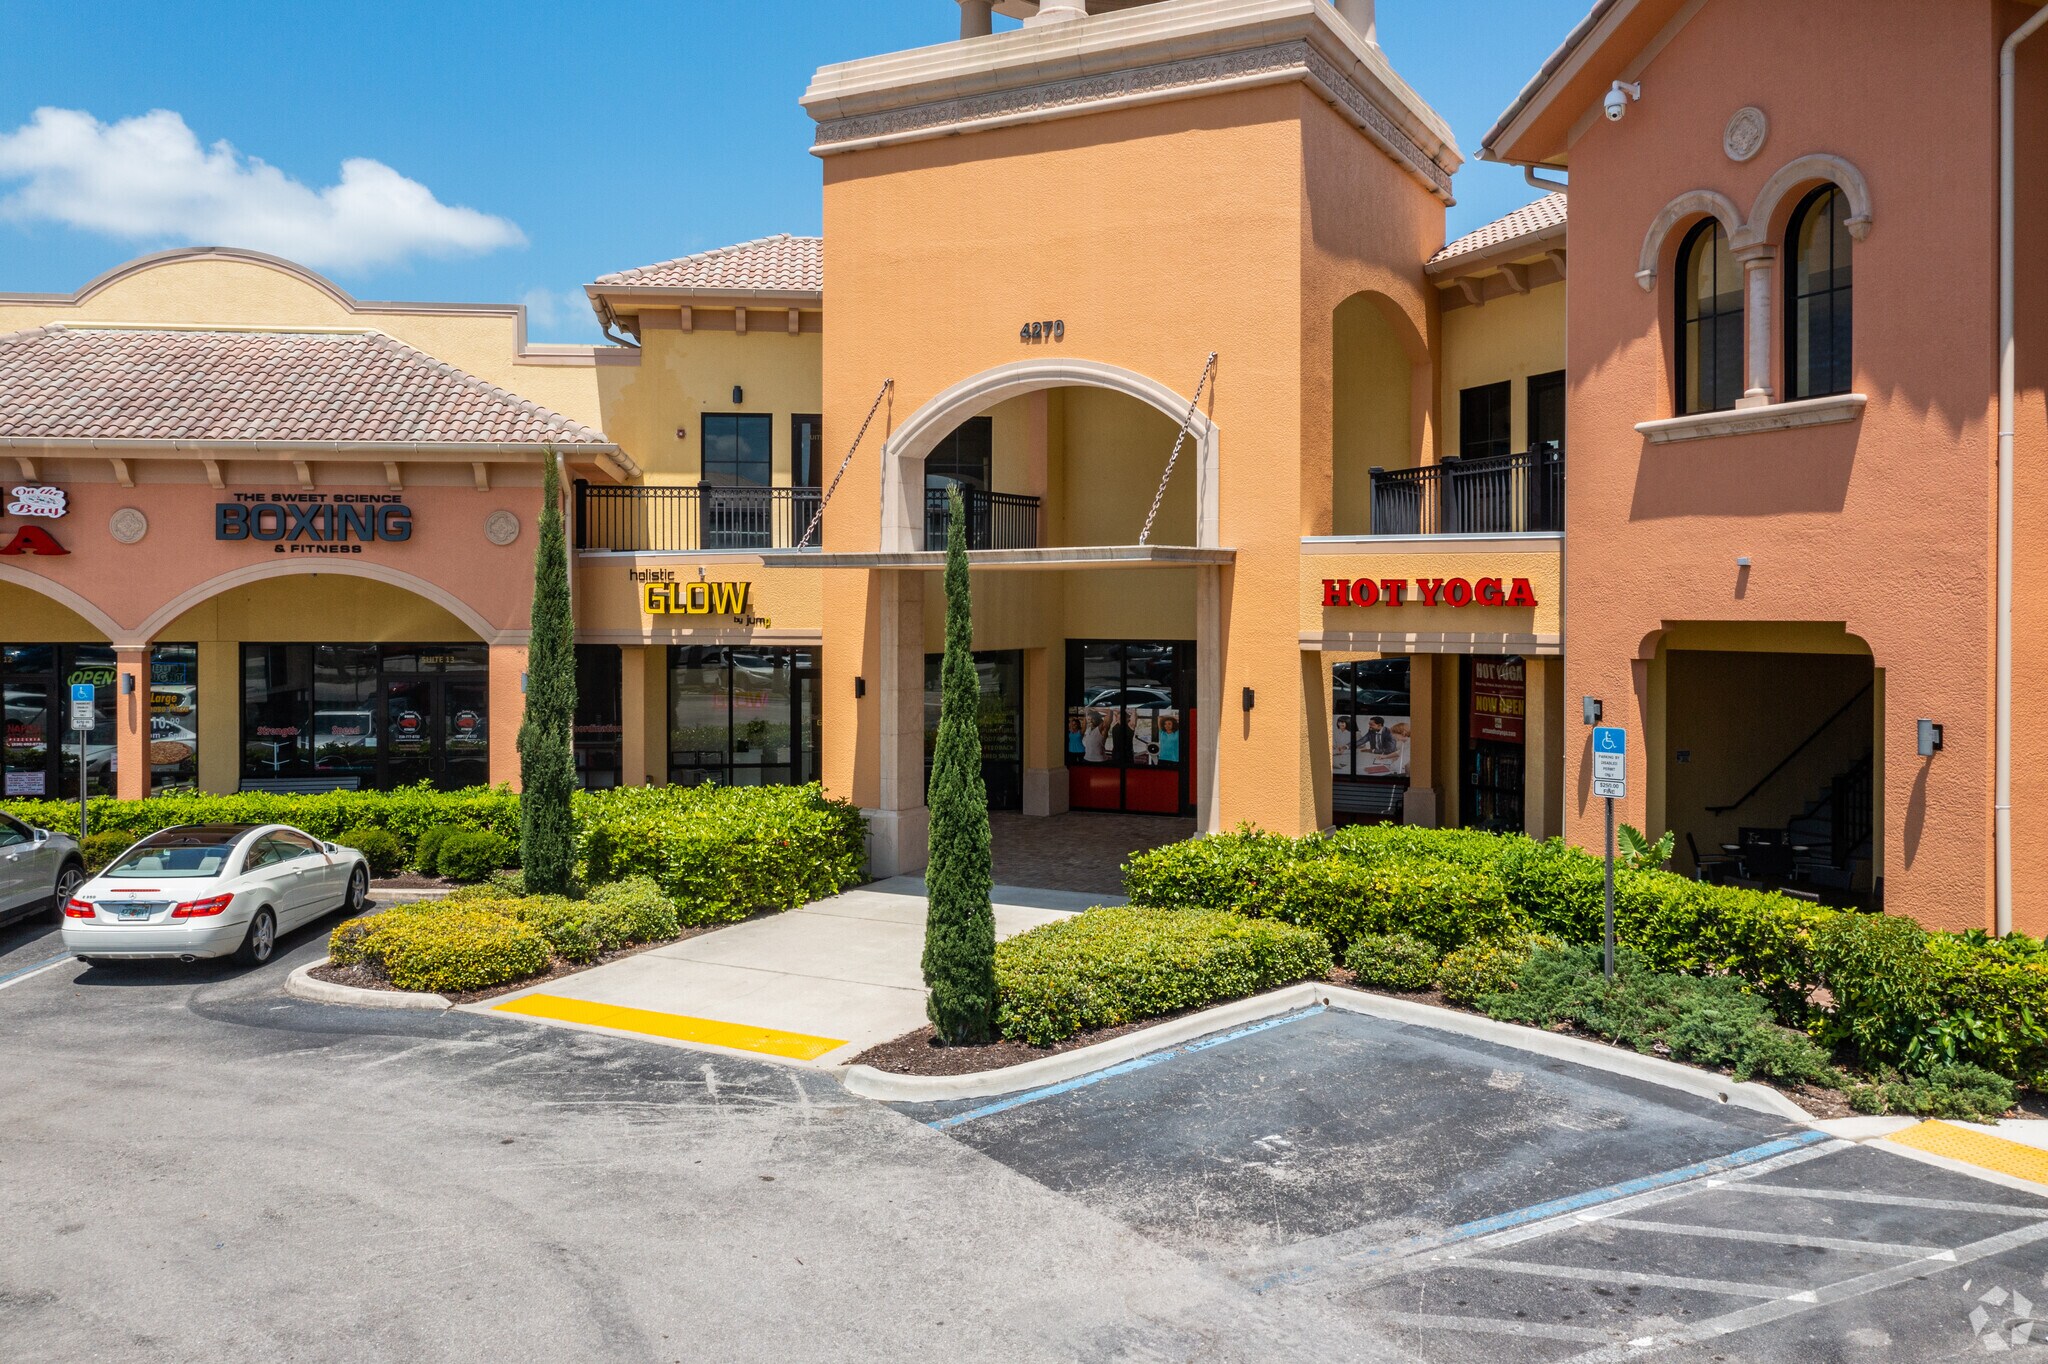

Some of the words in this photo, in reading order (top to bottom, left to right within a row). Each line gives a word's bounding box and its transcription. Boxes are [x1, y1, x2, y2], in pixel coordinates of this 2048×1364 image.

[1020, 320, 1064, 338] 4270
[39, 488, 62, 496] the
[234, 493, 265, 502] THE
[271, 493, 327, 503] SWEET
[333, 494, 402, 503] SCIENCE
[10, 503, 60, 517] Bay
[215, 503, 413, 542] BOXING
[274, 544, 286, 553] &
[290, 545, 362, 554] FITNESS
[629, 568, 675, 582] holistic
[644, 582, 751, 614] GLOW
[1322, 578, 1407, 607] HOT
[1416, 577, 1538, 607] YOGA
[733, 616, 743, 624] by
[745, 614, 772, 629] jump
[421, 656, 443, 664] SUITE
[70, 671, 115, 685] OPEN
[1475, 662, 1495, 679] HOT
[1496, 664, 1523, 681] YOGA
[150, 693, 177, 705] Large
[1475, 695, 1497, 712] NOW
[1499, 697, 1524, 715] OPEN
[151, 716, 181, 729] 10.99
[257, 726, 298, 737] Strength
